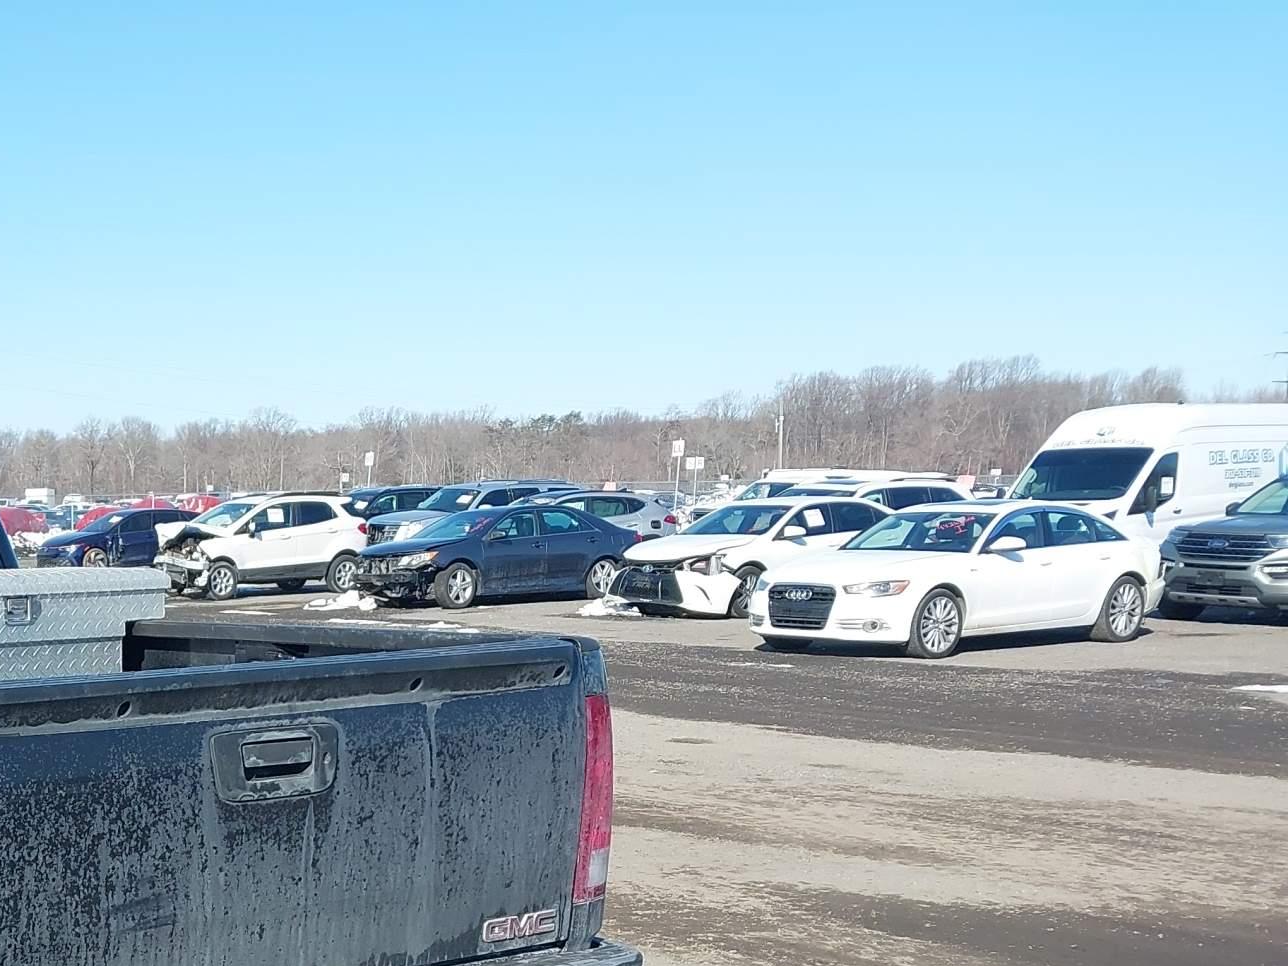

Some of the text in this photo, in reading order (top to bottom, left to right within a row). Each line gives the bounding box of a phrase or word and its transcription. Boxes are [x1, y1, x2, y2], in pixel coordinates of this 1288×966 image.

[1209, 450, 1228, 465] DEL
[1231, 449, 1259, 464] GLASS
[482, 908, 558, 943] GMC
